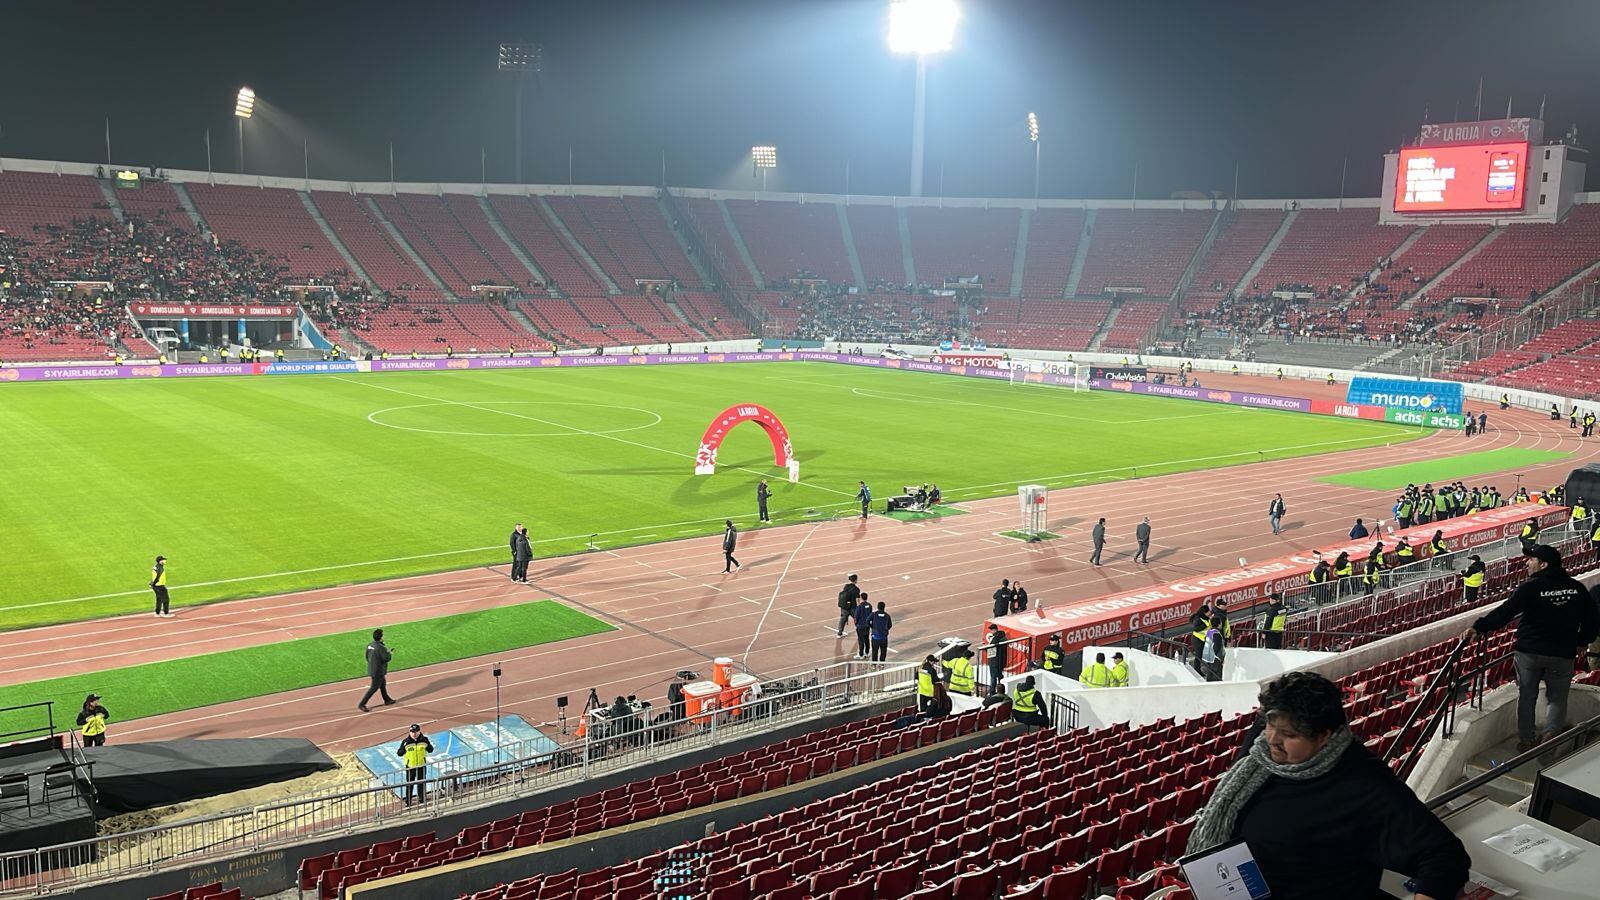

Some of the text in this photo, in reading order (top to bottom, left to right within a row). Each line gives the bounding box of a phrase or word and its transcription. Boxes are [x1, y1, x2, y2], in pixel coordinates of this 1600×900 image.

[1443, 126, 1480, 141] LA ROJA
[276, 364, 300, 372] WORLD
[301, 363, 315, 371] CUP
[944, 357, 1000, 368] MG MOTOR
[1334, 404, 1359, 417] LA ROJA
[1394, 411, 1422, 424] achs
[1431, 415, 1460, 428] achs
[1502, 524, 1509, 536] G
[1462, 534, 1469, 547] G
[1469, 528, 1498, 544] GATORADE
[1264, 573, 1311, 597] G GATORAD
[1053, 590, 1174, 620] GATORADE
[1129, 602, 1193, 631] G GATORADE
[1066, 619, 1123, 645] GATORADE
